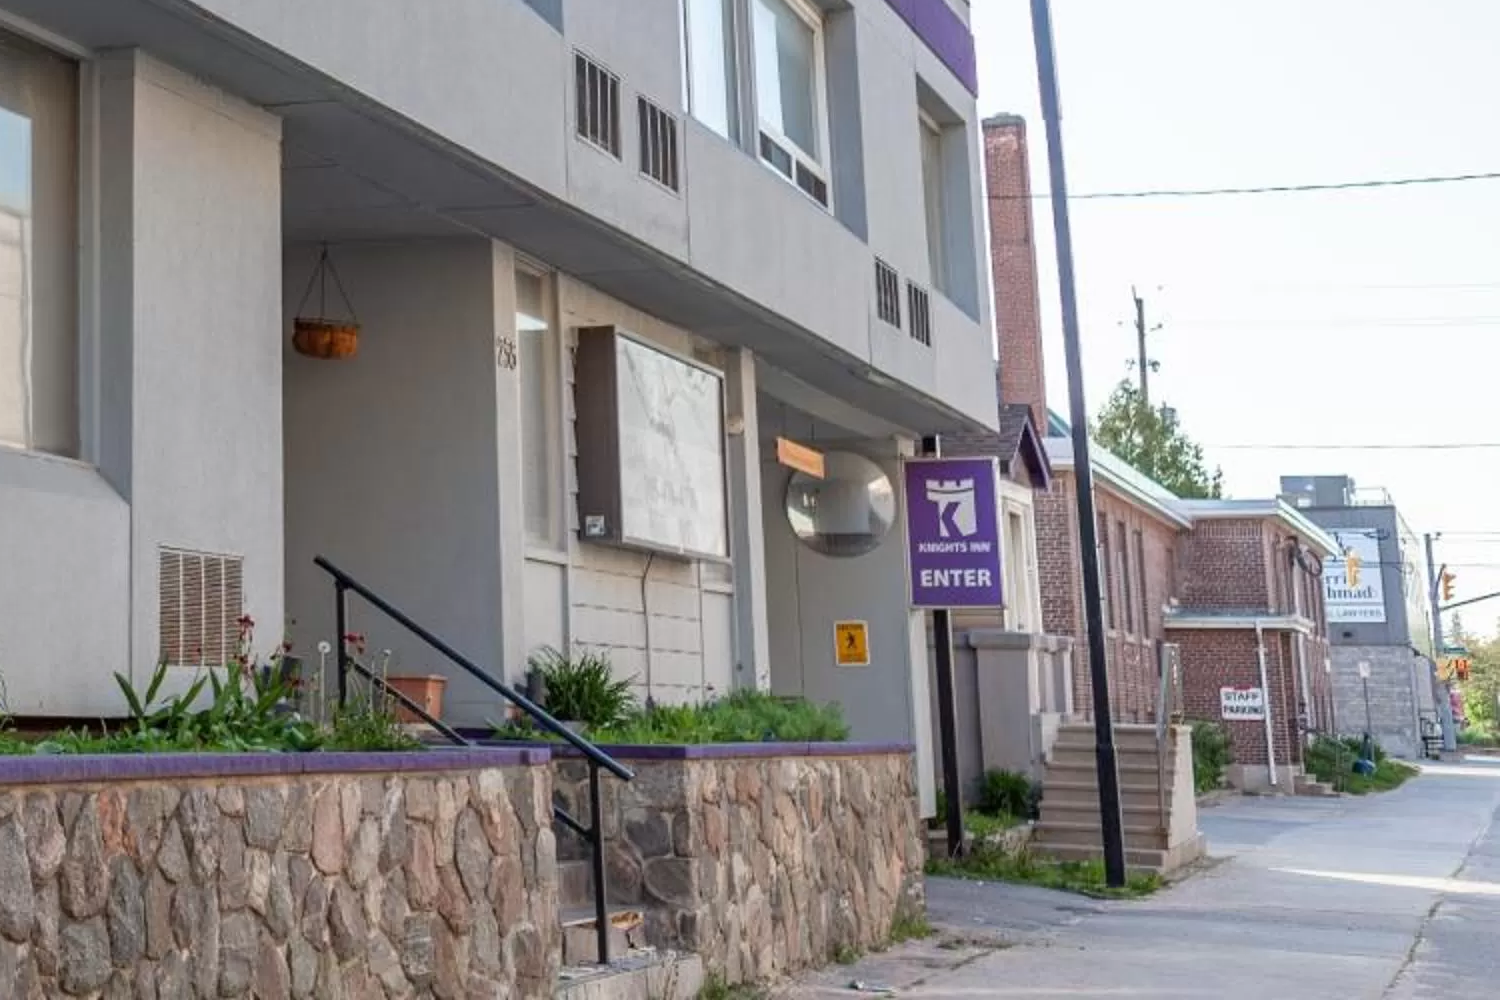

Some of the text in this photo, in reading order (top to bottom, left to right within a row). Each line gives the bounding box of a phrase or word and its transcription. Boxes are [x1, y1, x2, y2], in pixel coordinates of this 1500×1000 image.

[918, 541, 991, 553] KNIGHTS INN
[920, 568, 993, 588] ENTER
